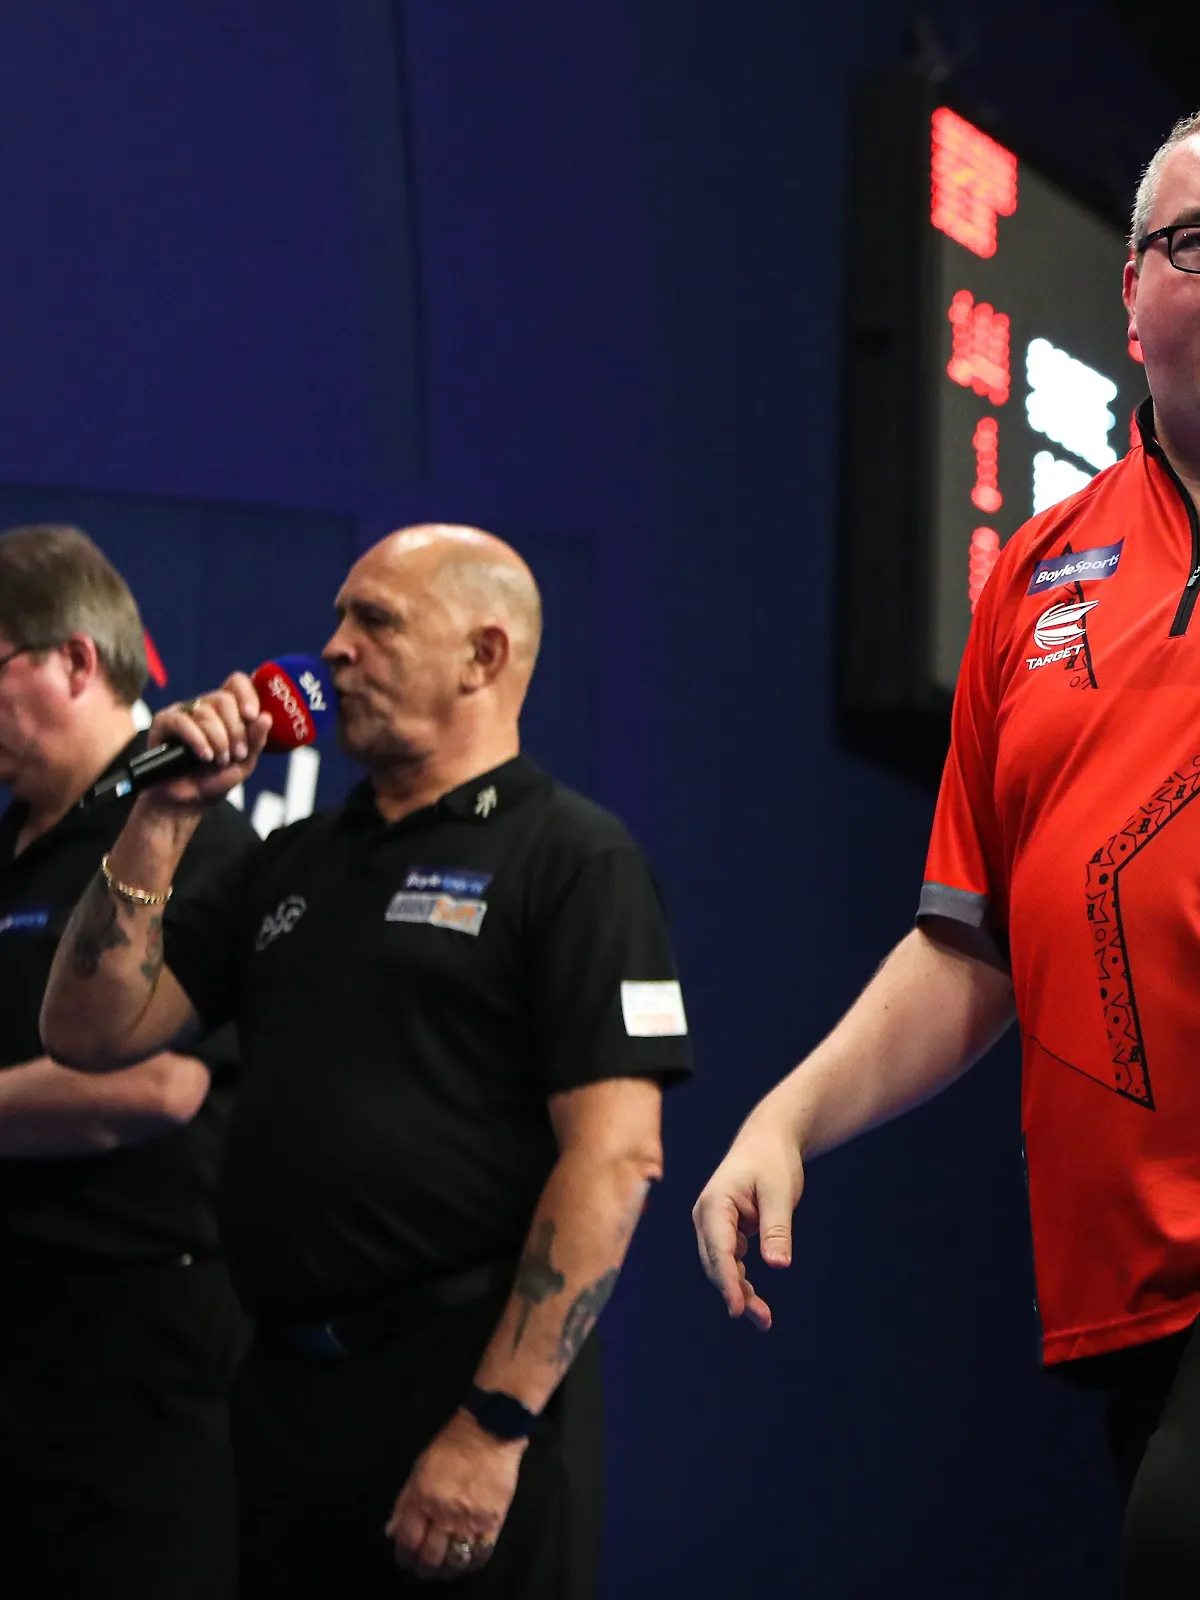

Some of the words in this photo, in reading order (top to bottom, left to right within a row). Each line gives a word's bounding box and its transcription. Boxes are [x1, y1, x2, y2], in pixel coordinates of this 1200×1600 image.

[1035, 553, 1120, 584] BoyleSports
[1026, 643, 1086, 671] TARGET
[268, 674, 310, 741] sports
[299, 670, 328, 712] sky
